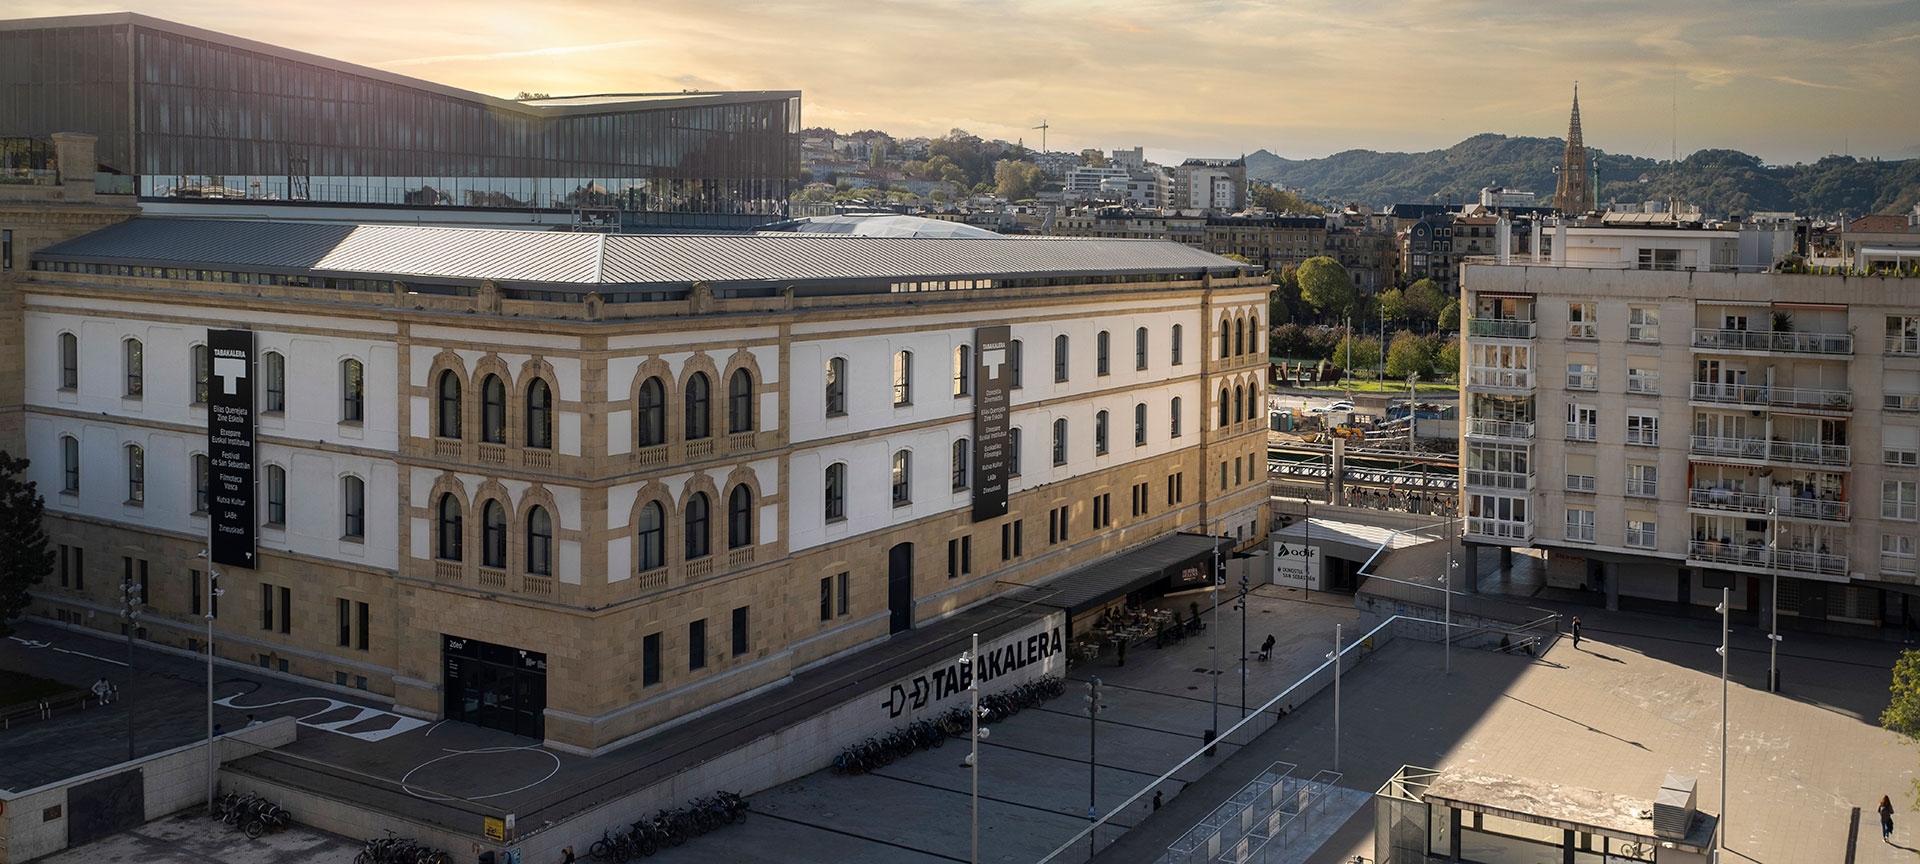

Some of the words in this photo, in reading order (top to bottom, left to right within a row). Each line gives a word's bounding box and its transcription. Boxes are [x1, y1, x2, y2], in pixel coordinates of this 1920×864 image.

[214, 349, 246, 358] TABAKALERA
[225, 406, 248, 416] Querejeta
[217, 414, 228, 422] Zine
[228, 415, 244, 423] Eskola
[220, 428, 241, 438] Etxepare
[212, 436, 226, 444] Euskal
[227, 437, 250, 447] Institutua
[221, 451, 240, 460] Festival
[211, 458, 218, 466] de
[218, 459, 228, 467] San
[219, 473, 243, 484] Filmoteca
[223, 482, 238, 491] Vasca
[231, 497, 246, 506] Kultur
[219, 523, 244, 535] Zineuskadi
[1282, 567, 1303, 575] DONOSTIA
[932, 627, 1062, 701] TABAKALERA
